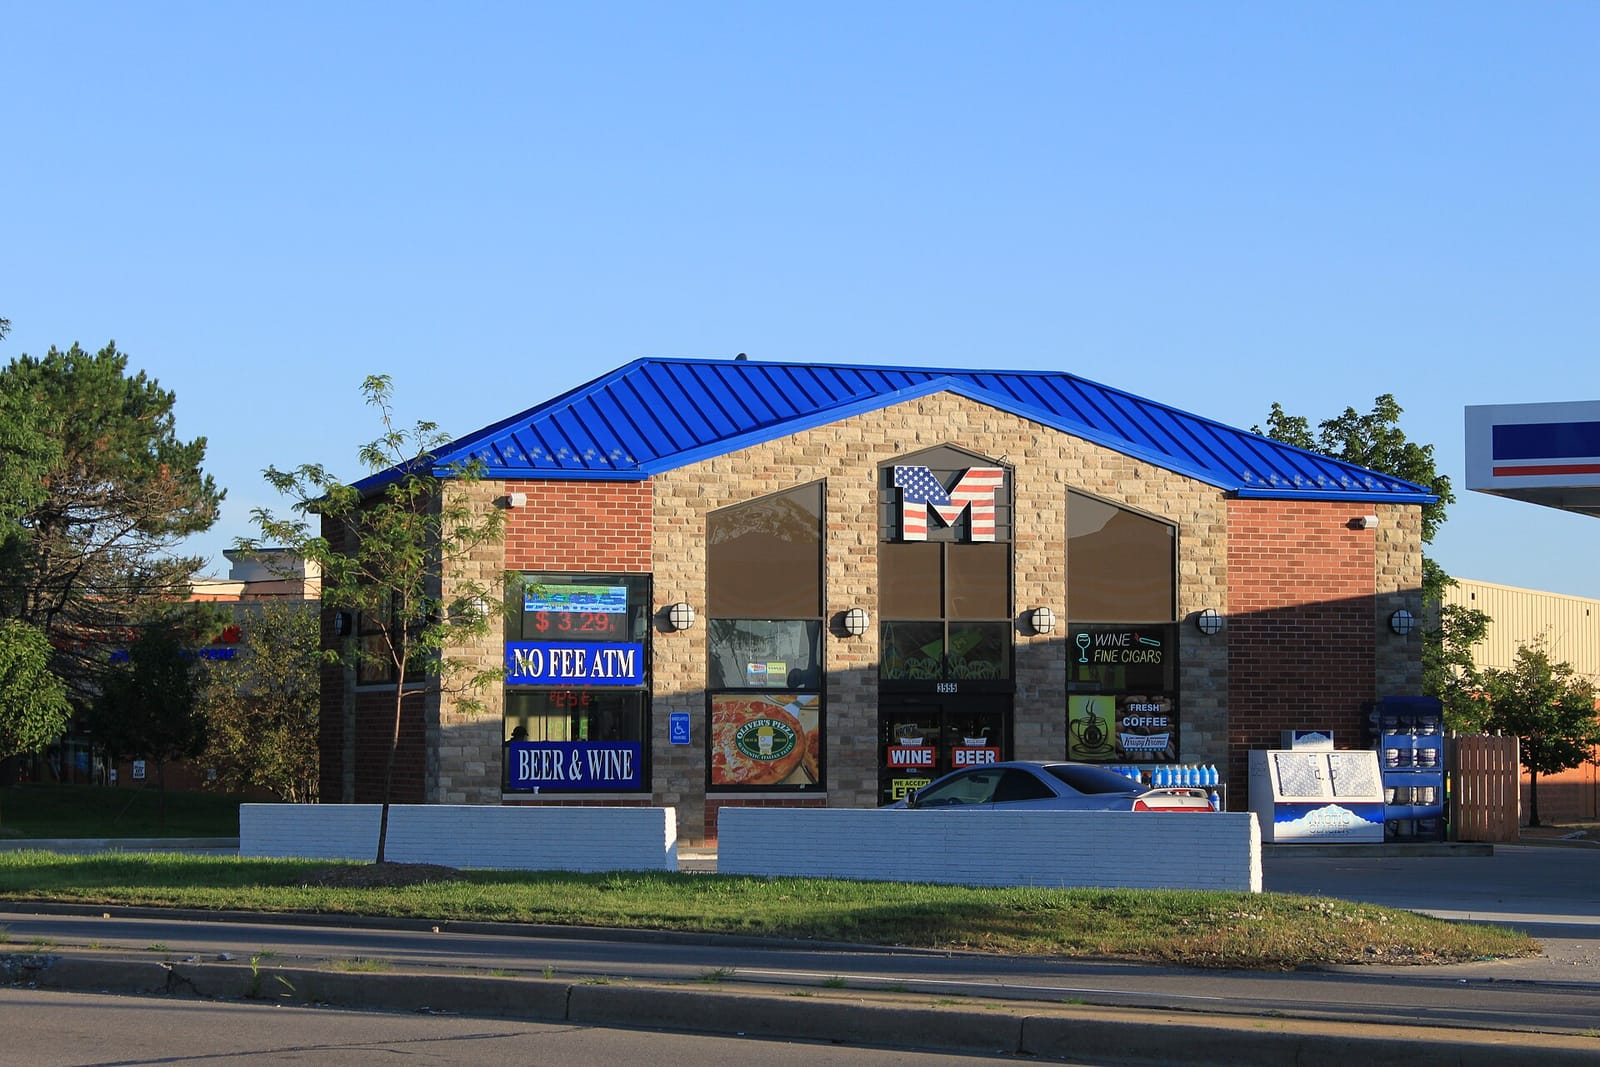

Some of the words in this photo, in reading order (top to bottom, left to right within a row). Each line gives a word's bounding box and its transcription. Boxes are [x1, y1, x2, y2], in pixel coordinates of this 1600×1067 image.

[893, 465, 1004, 542] M
[1095, 633, 1132, 647] WINE
[513, 648, 544, 678] NO
[548, 649, 587, 678] FEE
[590, 649, 635, 678] ATM
[1094, 649, 1119, 663] FINE
[1121, 649, 1162, 664] CIGARS
[937, 683, 957, 692] 3555
[1130, 703, 1160, 712] FRESH
[1122, 717, 1168, 727] COFFEE
[736, 720, 770, 739] OLIVER'S
[772, 720, 794, 739] PIZZA
[891, 749, 932, 764] WINE
[955, 750, 995, 764] BEER
[517, 749, 564, 781] BEER
[568, 749, 583, 781] &
[586, 749, 634, 781] WINE
[1309, 811, 1350, 824] ARCTIC
[1309, 824, 1350, 833] GLACIER
